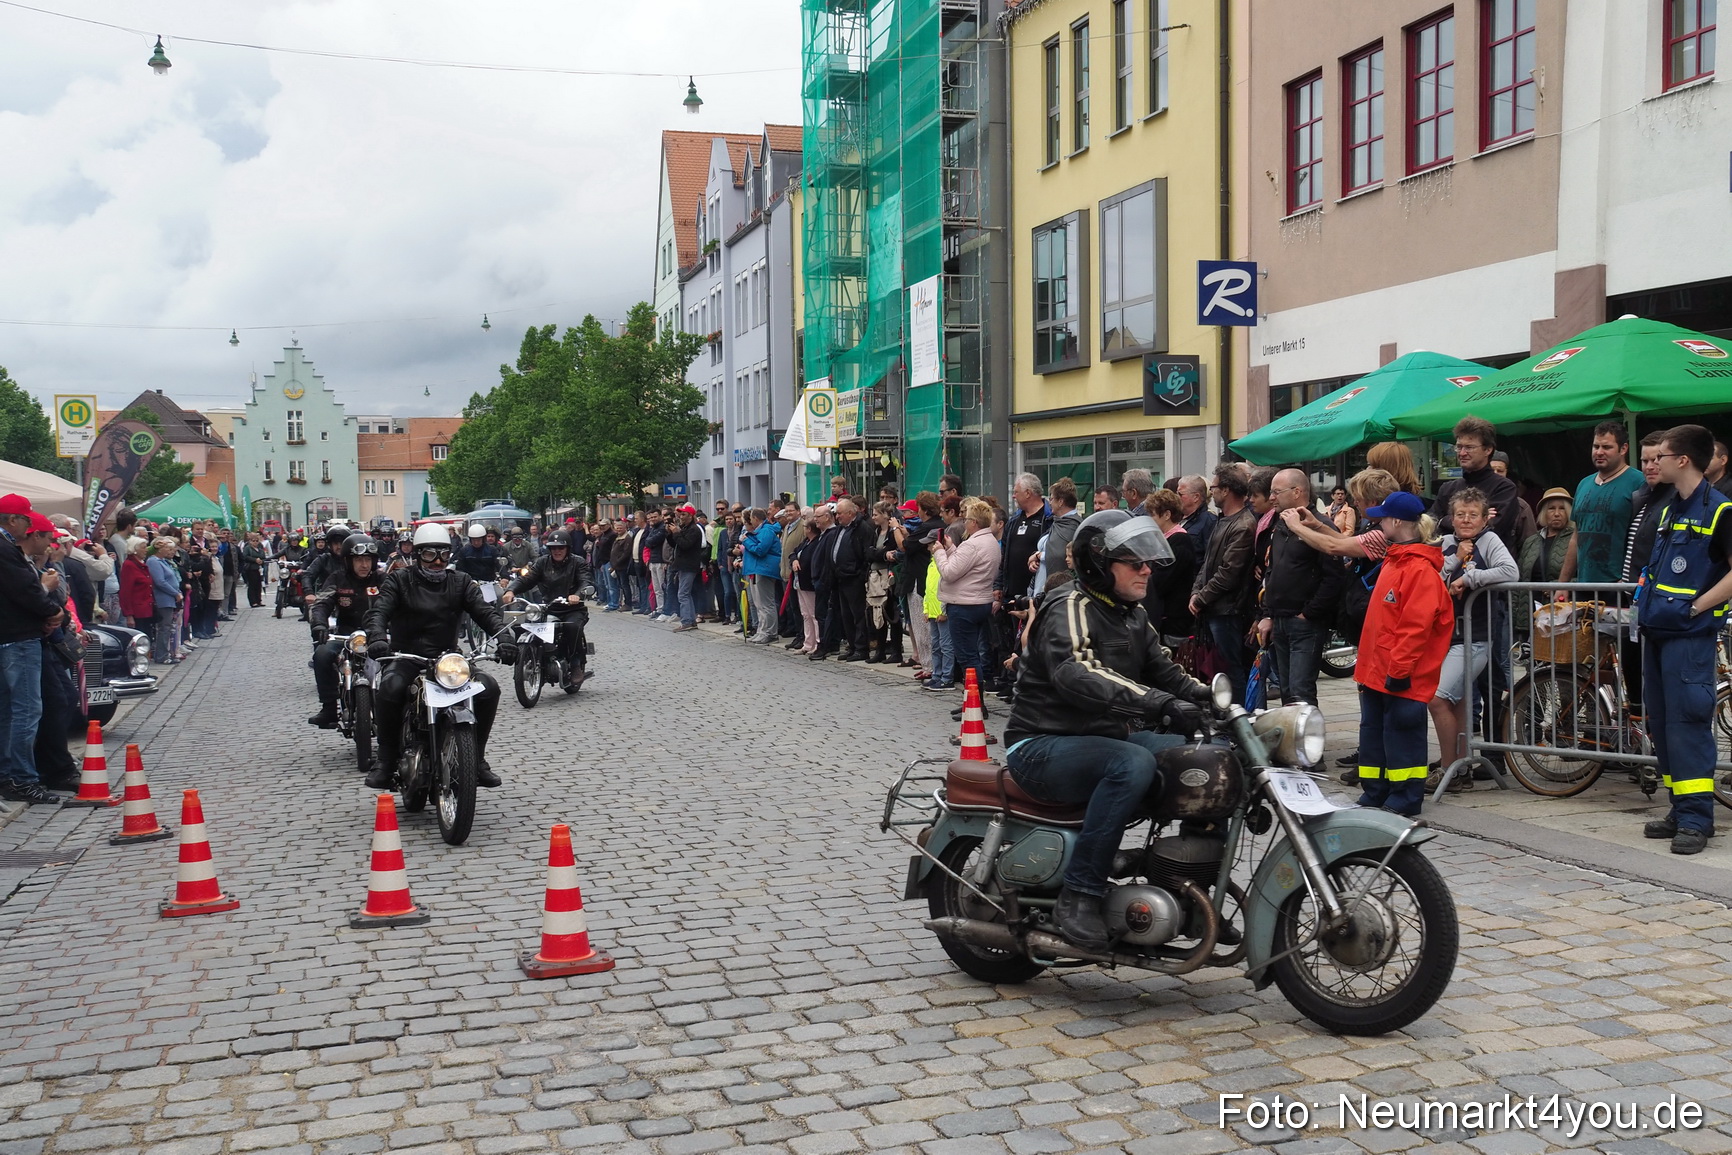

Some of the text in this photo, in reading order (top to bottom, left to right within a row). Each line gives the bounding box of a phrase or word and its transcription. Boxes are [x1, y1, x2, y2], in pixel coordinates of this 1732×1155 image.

[1262, 337, 1306, 356] Unterer Markt 15
[1166, 371, 1186, 396] G2
[1492, 371, 1567, 388] Neumarkter
[1463, 379, 1565, 403] Lammsbräu
[68, 405, 84, 421] H
[816, 398, 826, 412] H
[1296, 782, 1312, 796] 487
